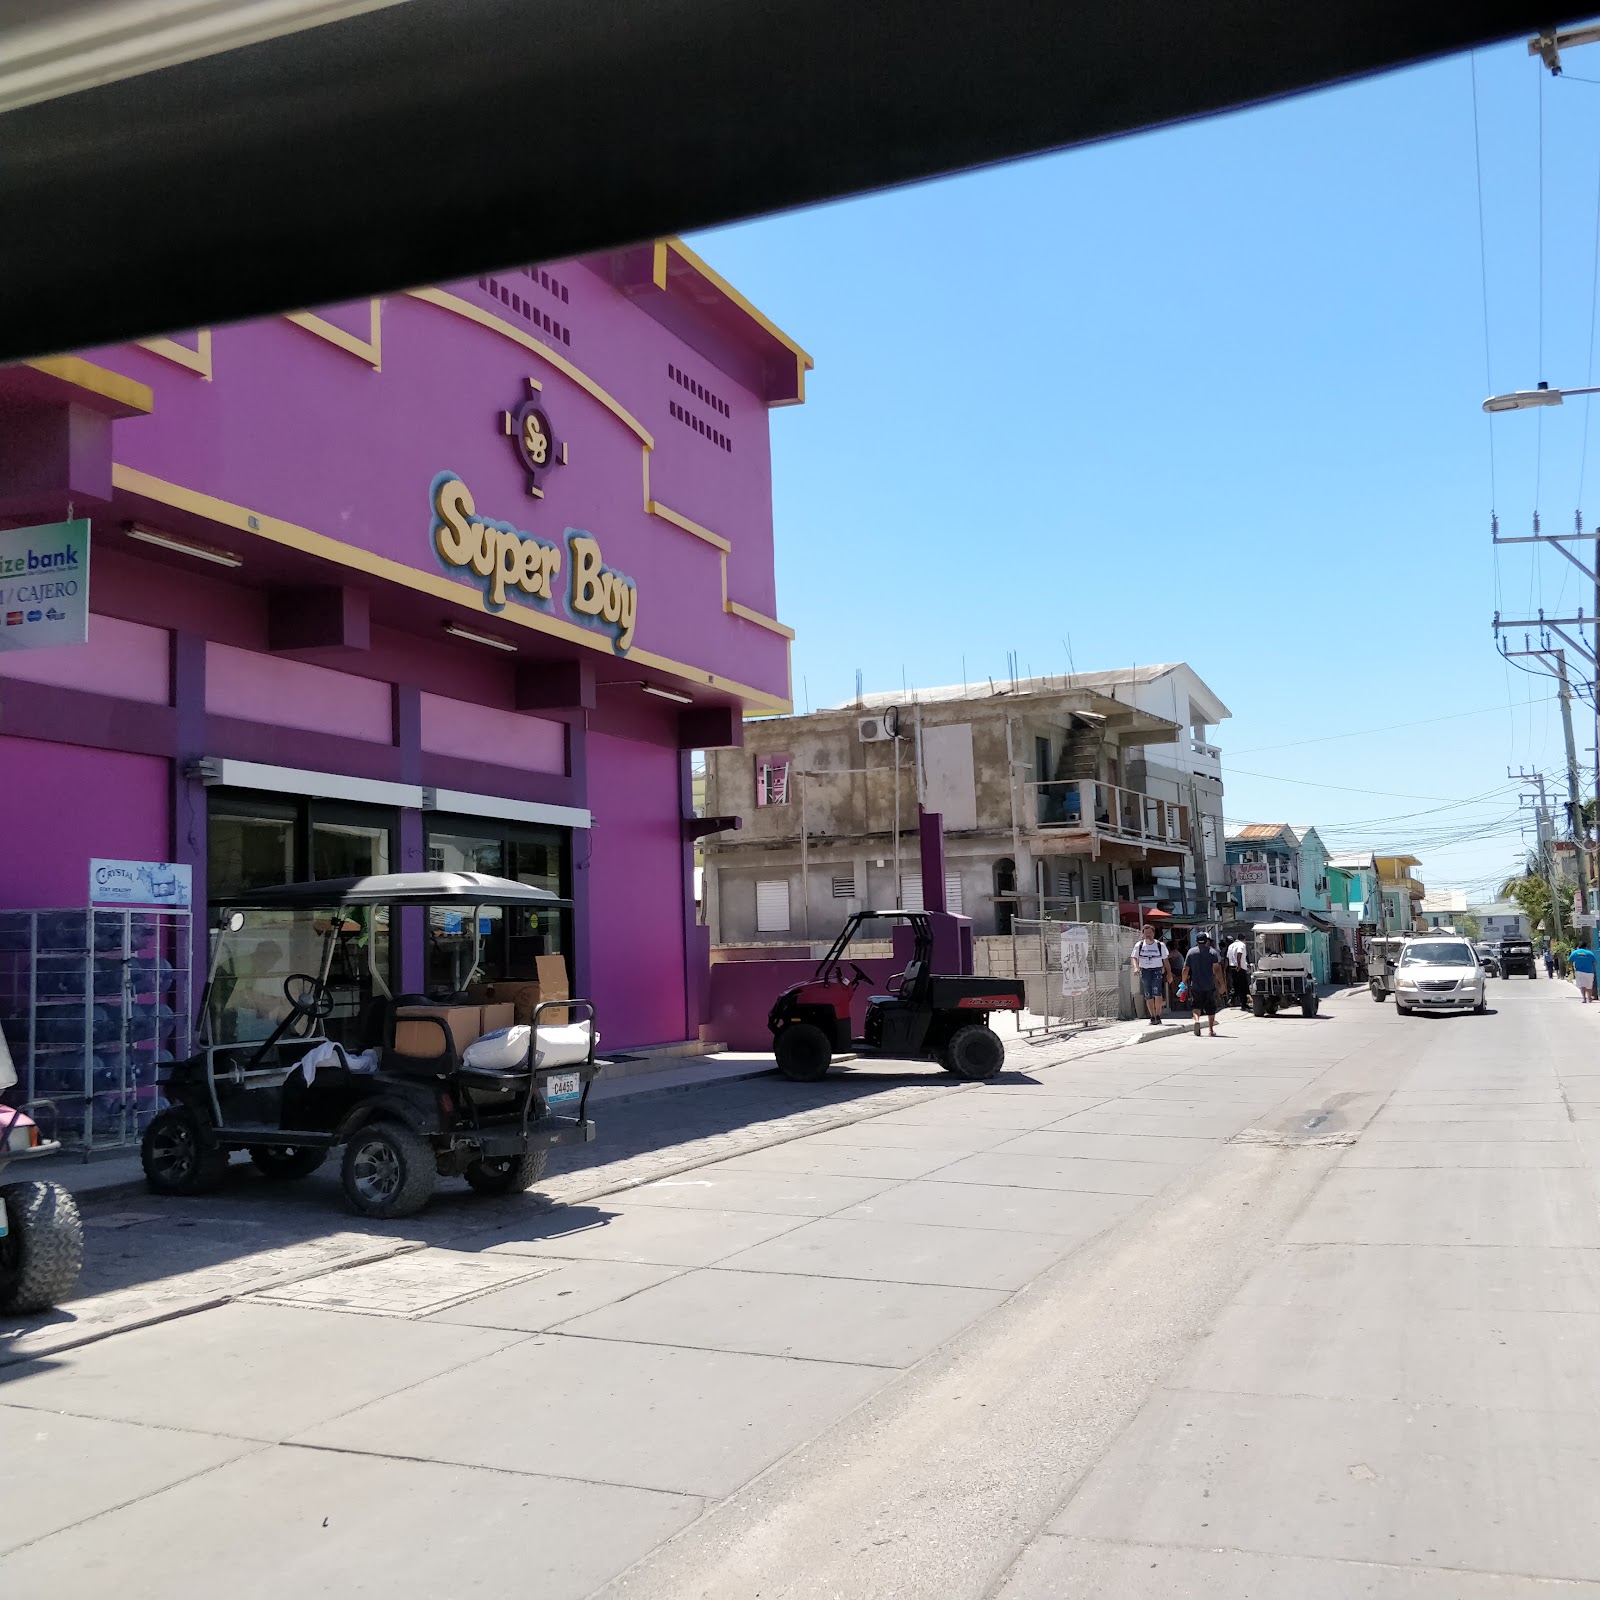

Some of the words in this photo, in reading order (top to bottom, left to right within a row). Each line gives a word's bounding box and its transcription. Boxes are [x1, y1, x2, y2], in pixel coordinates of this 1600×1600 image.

[435, 479, 561, 605] Super
[570, 537, 637, 650] Buy
[17, 580, 78, 604] CAJERO
[95, 867, 134, 885] CRYSTAL
[1238, 872, 1263, 881] TACOS
[554, 1081, 574, 1095] C4455
